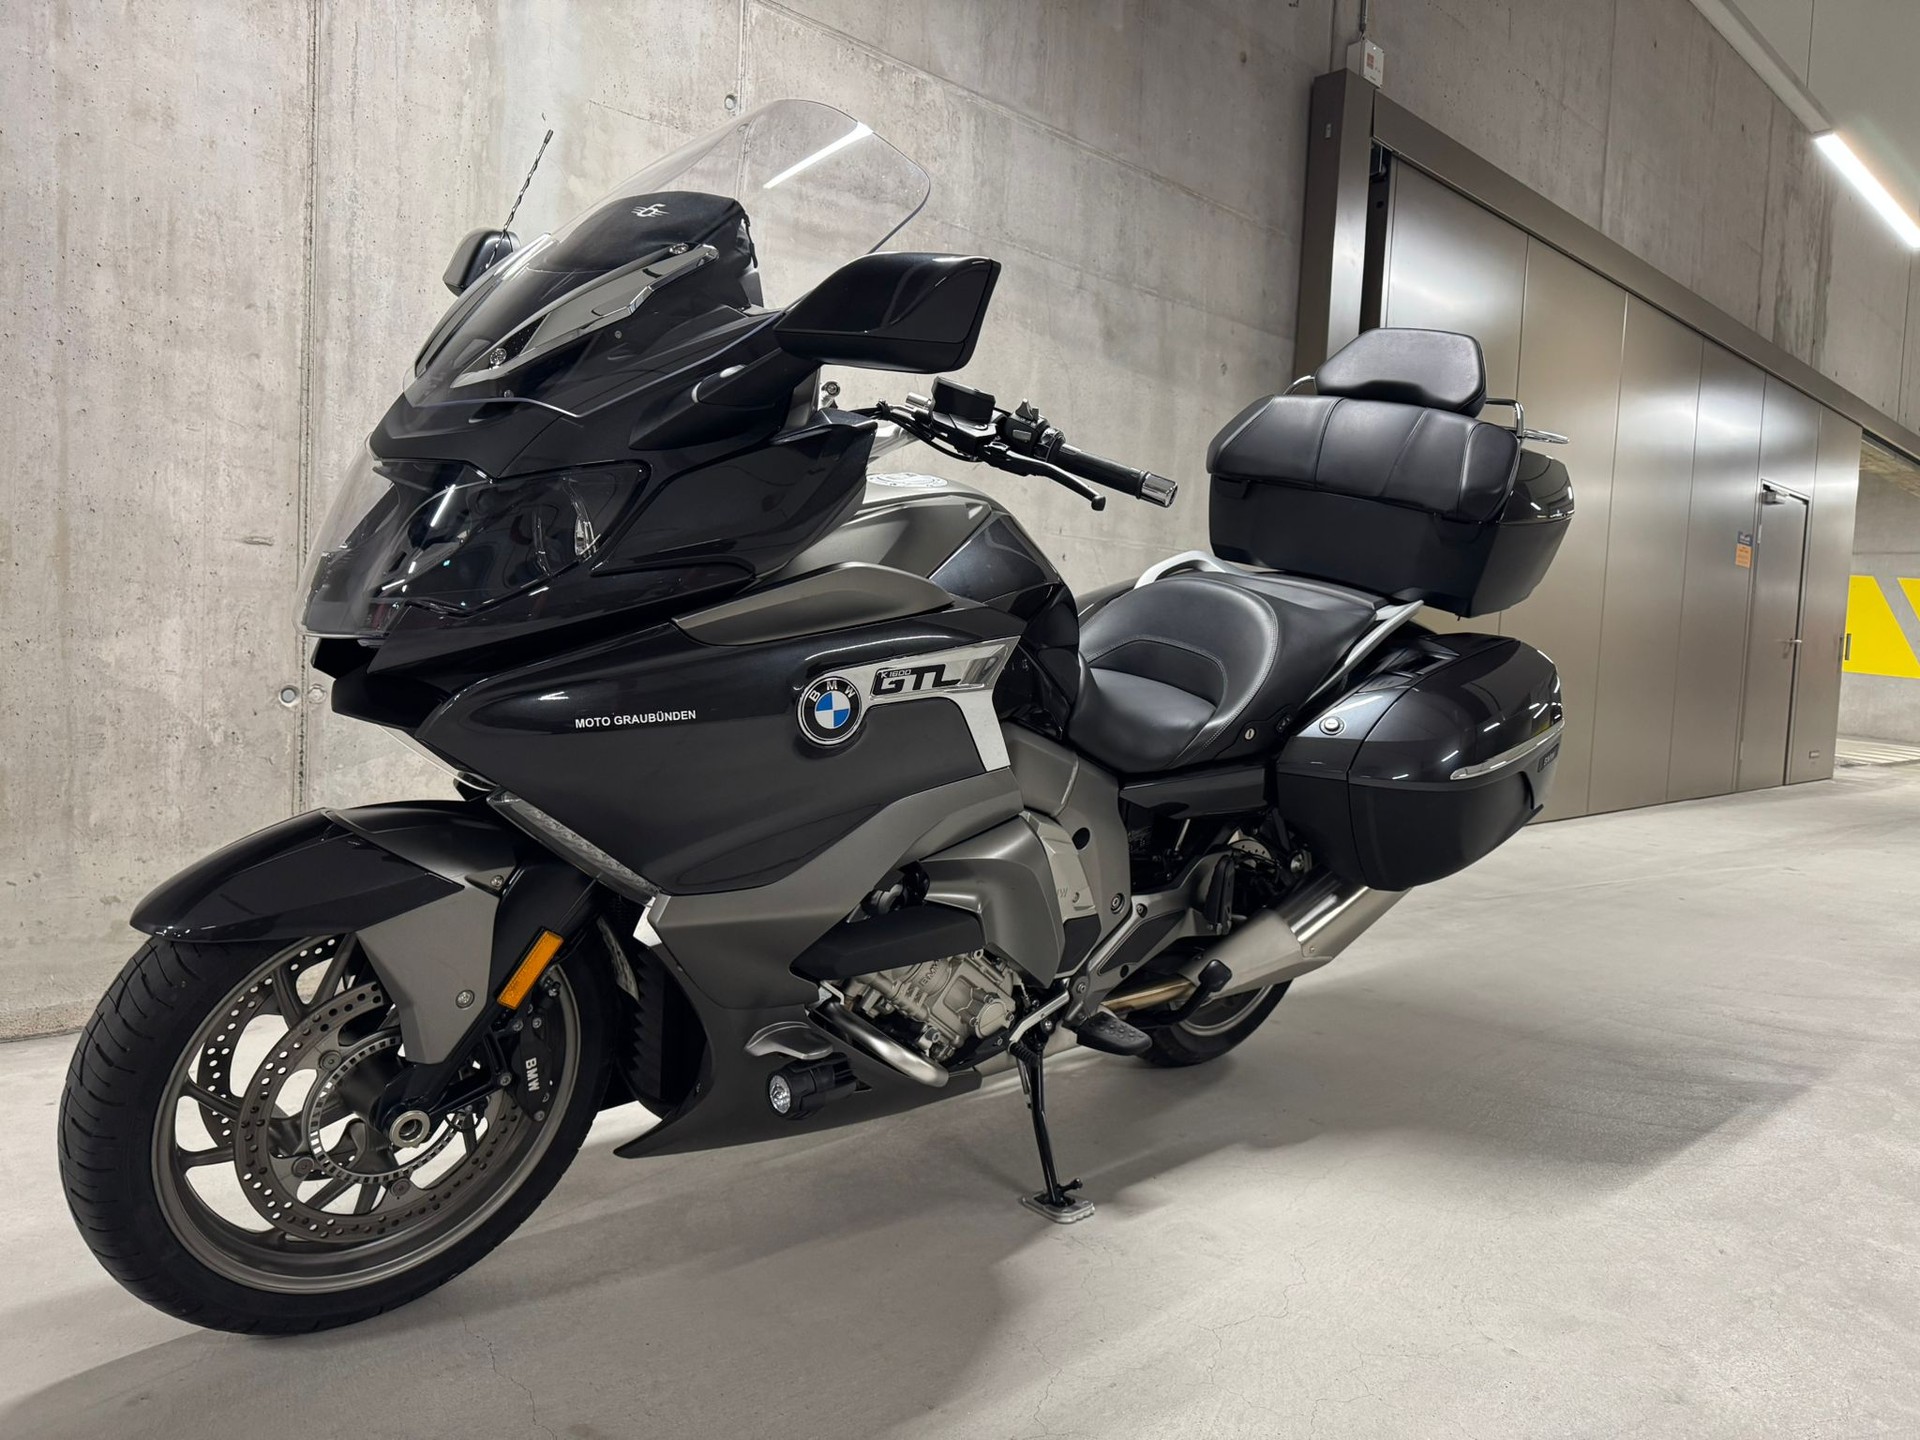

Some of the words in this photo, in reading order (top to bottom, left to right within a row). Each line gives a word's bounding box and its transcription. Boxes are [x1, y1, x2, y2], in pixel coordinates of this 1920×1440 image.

[872, 664, 962, 696] GTL
[889, 669, 912, 678] 1600
[808, 679, 857, 703] BMW
[574, 716, 612, 729] MOTO
[613, 710, 697, 726] GRAUBÜNDEN
[525, 1057, 541, 1092] BMW
